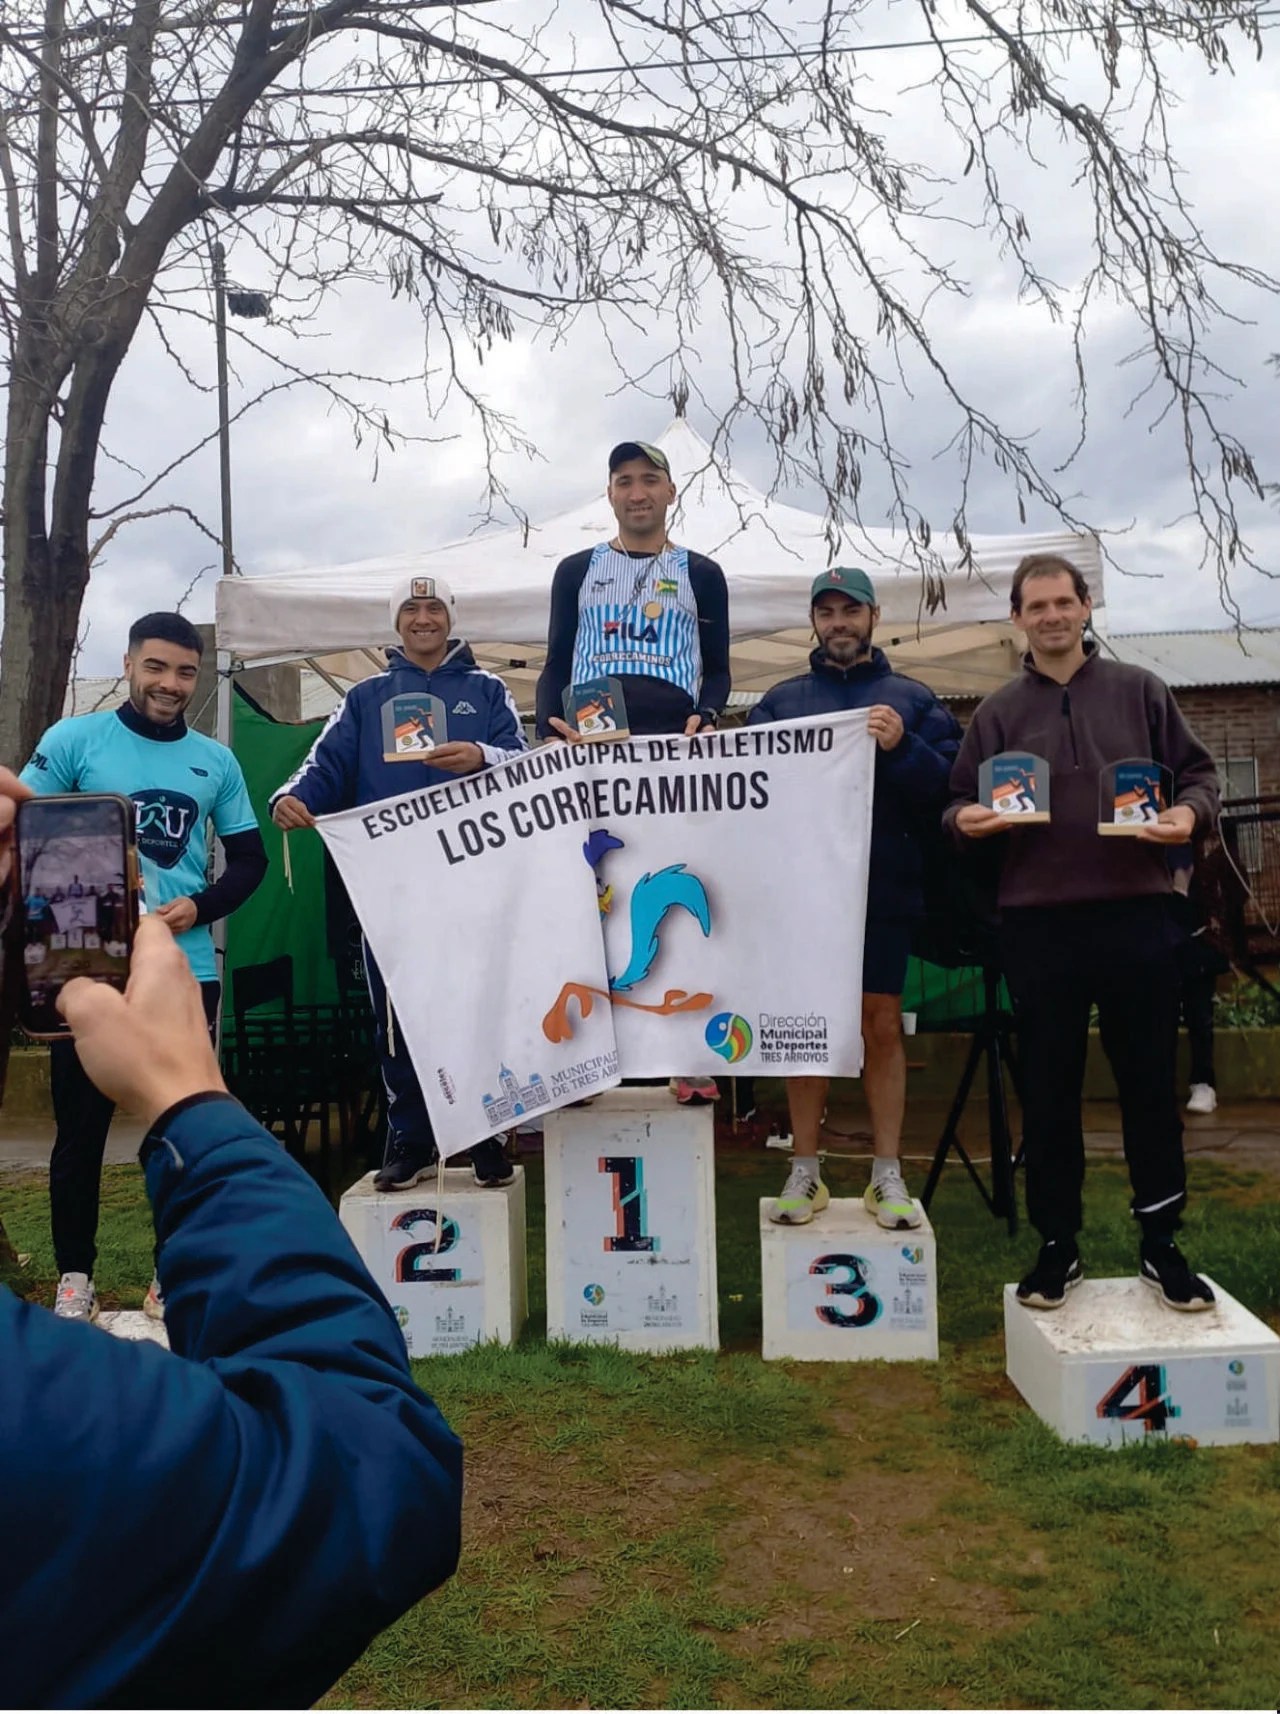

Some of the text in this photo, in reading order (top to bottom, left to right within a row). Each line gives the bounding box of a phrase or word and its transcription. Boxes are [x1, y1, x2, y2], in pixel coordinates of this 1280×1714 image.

[604, 621, 659, 643] FILA
[592, 652, 672, 667] CORRECAMINOS
[362, 727, 834, 840] ESCUELITA MUNICIPAL DE ATLETISMO
[437, 771, 769, 865] LOS CORRECAMINOS
[759, 1011, 827, 1028] Dirección
[760, 1027, 827, 1040] Municipal
[760, 1041, 828, 1053] de Deportes
[760, 1052, 829, 1063] TRES ARROYOS
[552, 1083, 569, 1098] DE
[570, 1071, 599, 1091] TRES
[598, 1156, 661, 1252] 1
[391, 1208, 460, 1282] 2
[809, 1253, 884, 1328] 3
[1096, 1364, 1181, 1431] 4
